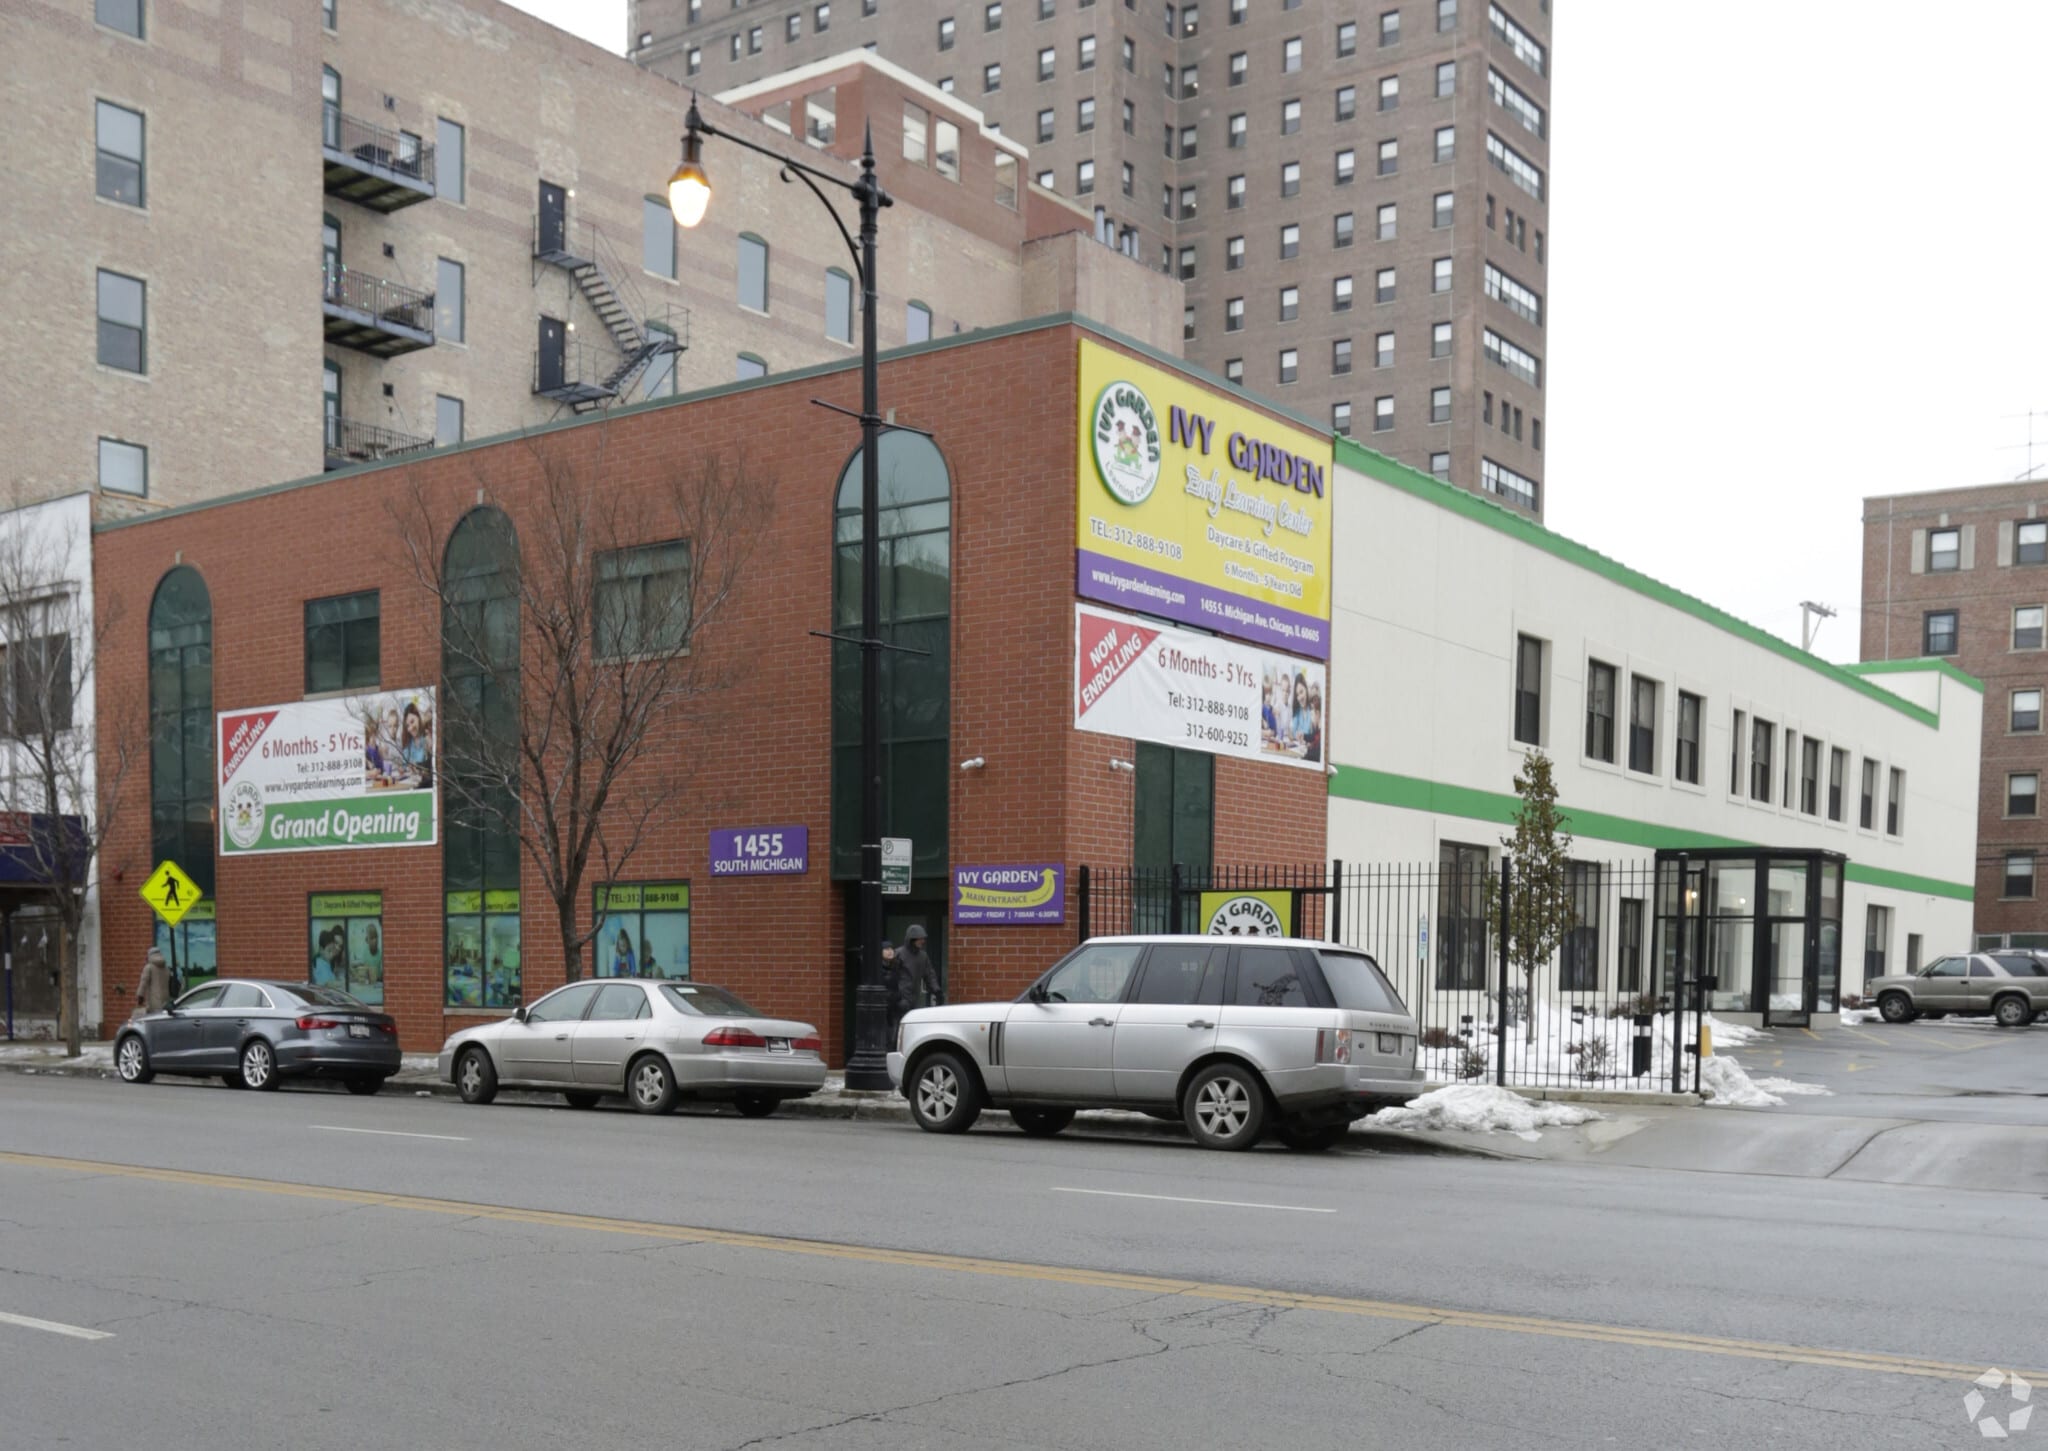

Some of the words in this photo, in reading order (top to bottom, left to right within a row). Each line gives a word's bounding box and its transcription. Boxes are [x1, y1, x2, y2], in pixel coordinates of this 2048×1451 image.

[1098, 397, 1115, 443] IVY
[1170, 404, 1216, 455] IVY
[1228, 432, 1324, 498] GARDEN
[1186, 464, 1222, 518] Early
[1223, 479, 1276, 537] Learning
[1278, 499, 1313, 537] Center
[1090, 518, 1112, 539] TEL:
[1115, 527, 1182, 560] 312-888-9108
[1208, 527, 1244, 550] Daycare
[1245, 540, 1251, 553] &
[1254, 543, 1278, 562] Gifted
[1280, 552, 1314, 574] Program
[1092, 569, 1185, 604] www.ivygardenlearning.com
[1225, 562, 1230, 575] 6
[1231, 564, 1259, 583] Months
[1264, 575, 1269, 587] 5
[1270, 576, 1288, 593] Years
[1289, 583, 1302, 596] Old
[1201, 598, 1217, 614] 1455
[1217, 603, 1224, 616] S.
[1224, 604, 1254, 625] Michigan
[1255, 613, 1268, 628] Ave.
[1088, 627, 1118, 669] NOW
[1081, 632, 1143, 706] ENROLLING
[1158, 649, 1166, 667] 6
[1169, 650, 1217, 679] Months
[1227, 663, 1234, 682] 5
[1236, 664, 1256, 689] Yrs.
[1168, 691, 1184, 708] Tel:
[1186, 696, 1249, 721] 312-888-9108
[223, 718, 266, 778] ENROLLING
[228, 720, 249, 751] NOW
[262, 743, 270, 759] 6
[273, 736, 318, 757] Months
[329, 737, 336, 752] 5
[339, 733, 363, 750] Yrs.
[1186, 722, 1249, 747] 312-600-9252
[298, 763, 309, 773] Tel:
[311, 759, 363, 773] 312-888-9108
[264, 777, 362, 793] www.ivygardenlearning.com
[270, 810, 330, 840] Grand
[333, 806, 420, 843] Opening
[734, 833, 783, 857] 1455
[714, 860, 748, 873] SOUTH
[750, 857, 803, 871] MICHIGAN
[959, 871, 979, 884] IVY
[982, 870, 1038, 885] GARDEN
[965, 892, 985, 902] MAIN
[987, 895, 1027, 904] ENTRANCE
[1211, 914, 1228, 935] VY
[1229, 902, 1280, 937] GARDE
